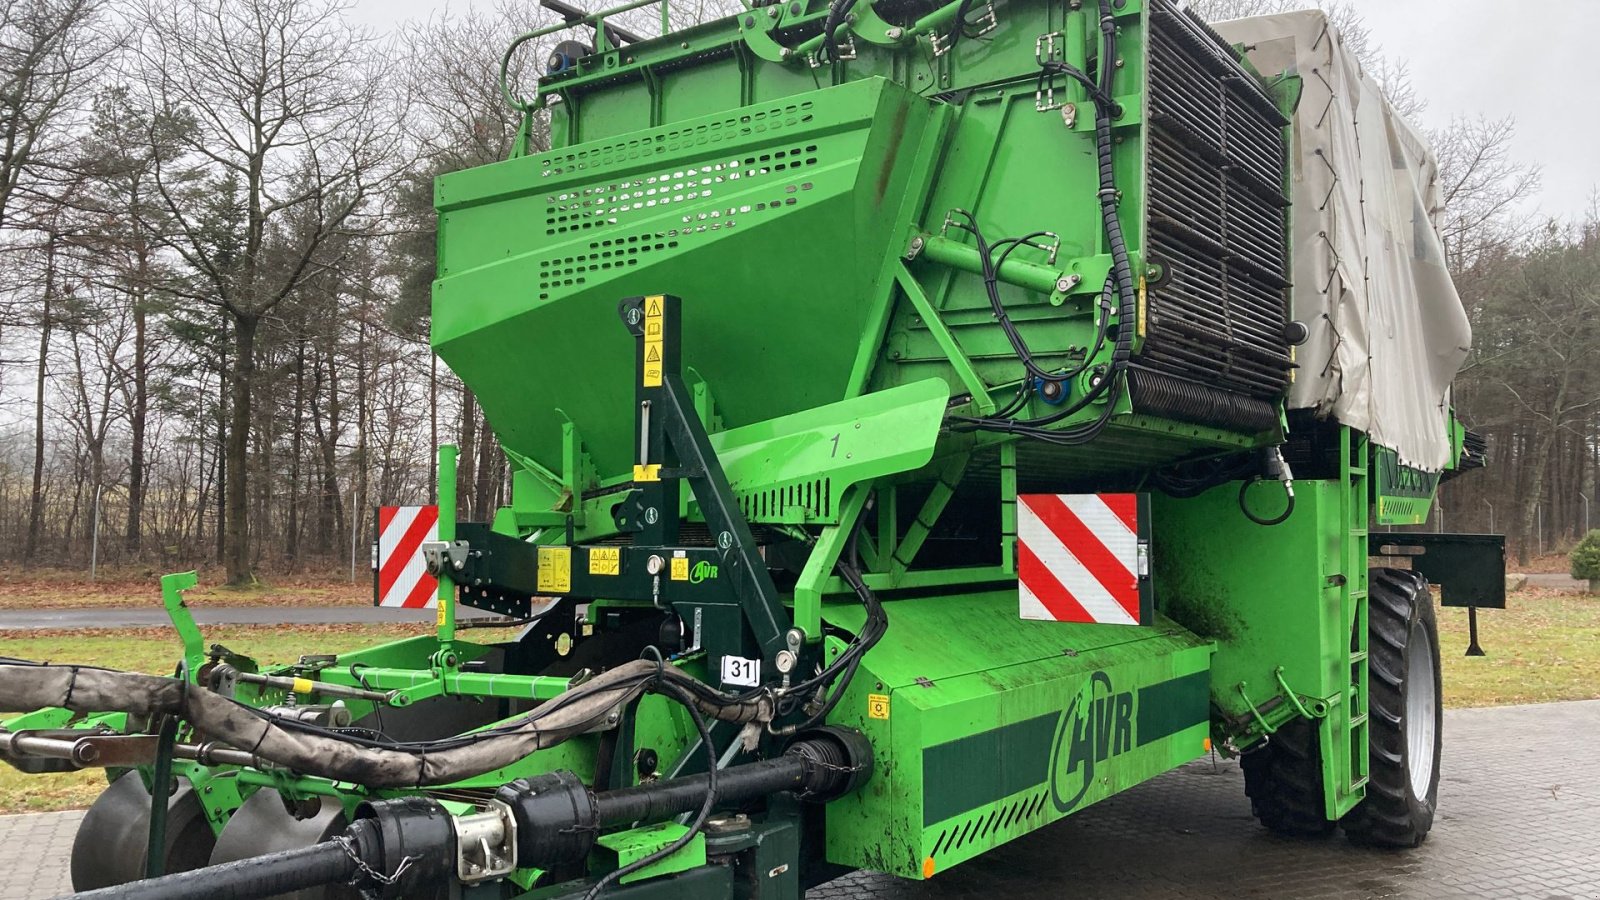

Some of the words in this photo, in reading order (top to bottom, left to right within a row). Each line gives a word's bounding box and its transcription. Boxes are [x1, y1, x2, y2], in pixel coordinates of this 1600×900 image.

[831, 433, 840, 458] 1
[690, 561, 718, 583] AVR
[731, 660, 750, 679] 31
[1055, 671, 1133, 808] AVR
